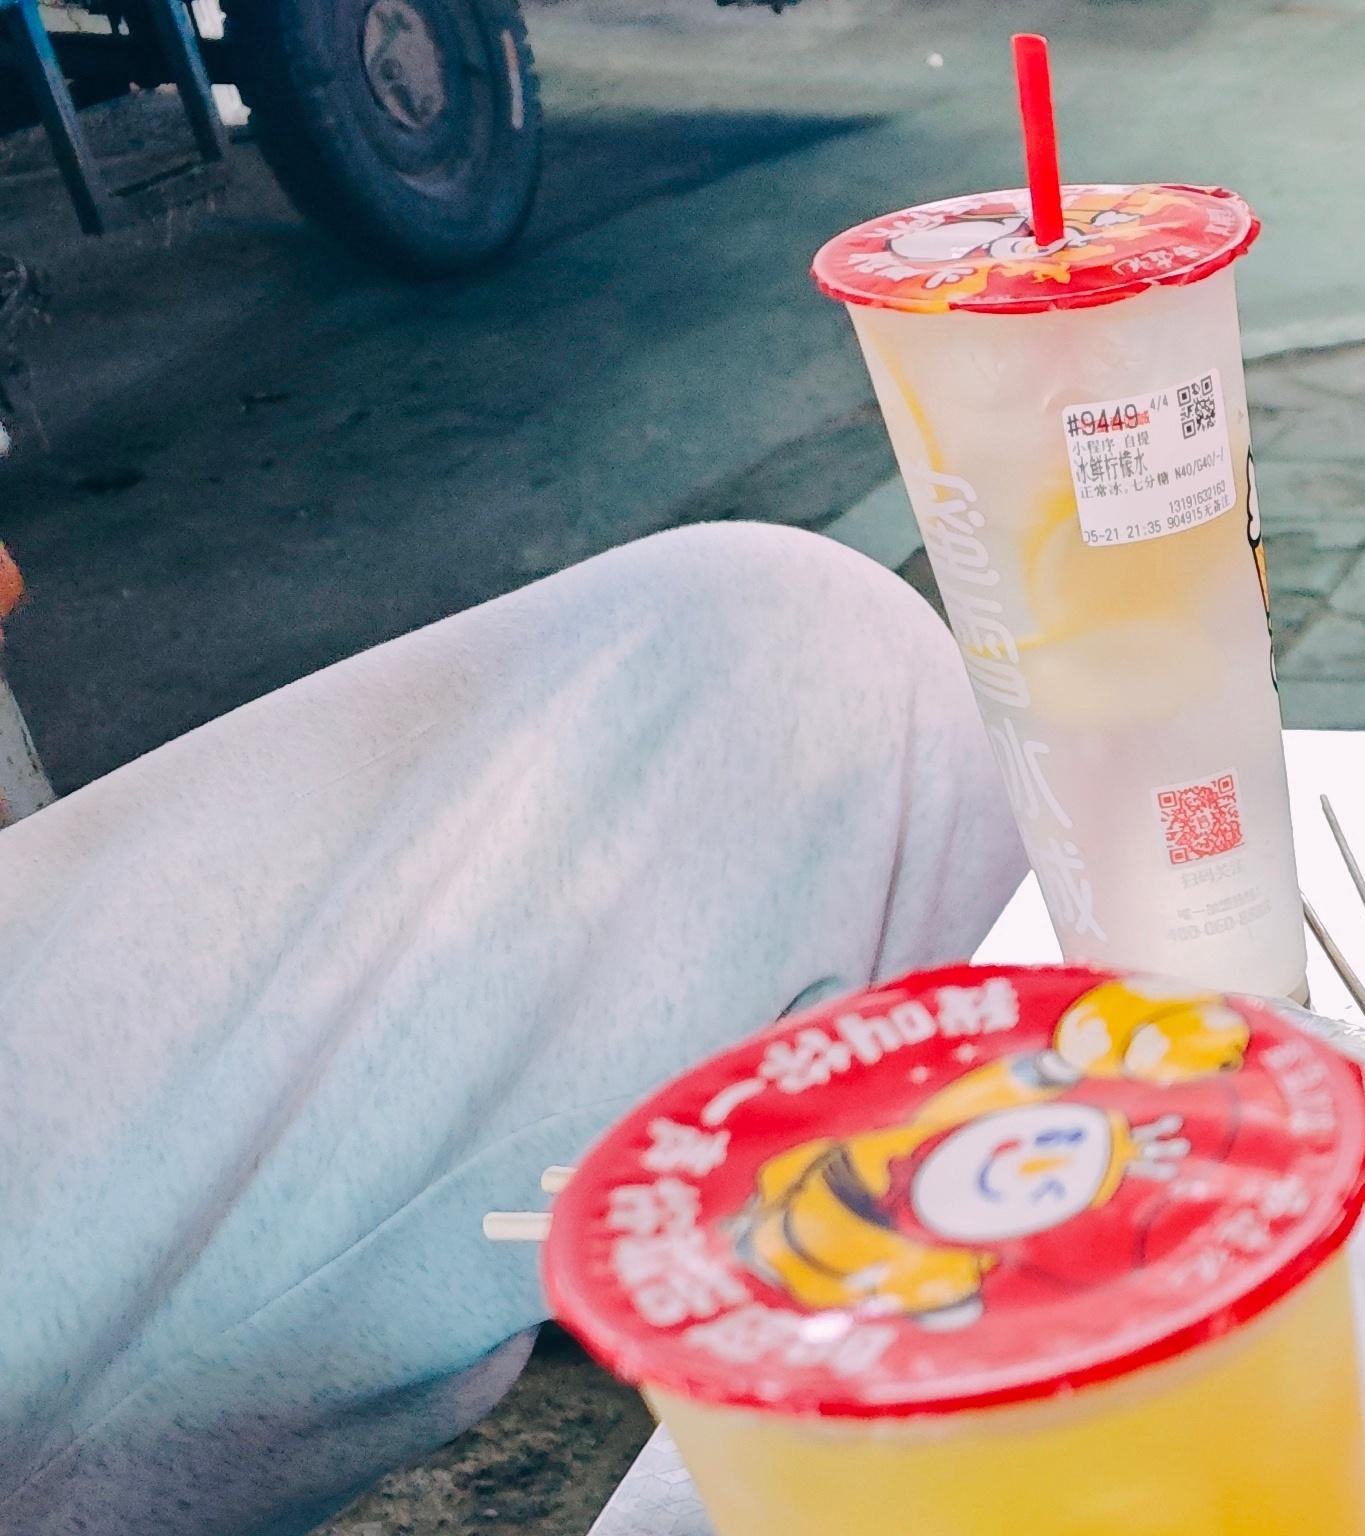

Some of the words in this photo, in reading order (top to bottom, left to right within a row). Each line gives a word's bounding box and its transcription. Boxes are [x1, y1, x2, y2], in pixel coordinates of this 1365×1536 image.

[1067, 404, 1139, 437] #9449
[1074, 447, 1148, 484] 冰鲜柠檬水
[1126, 519, 1162, 539] 21:35
